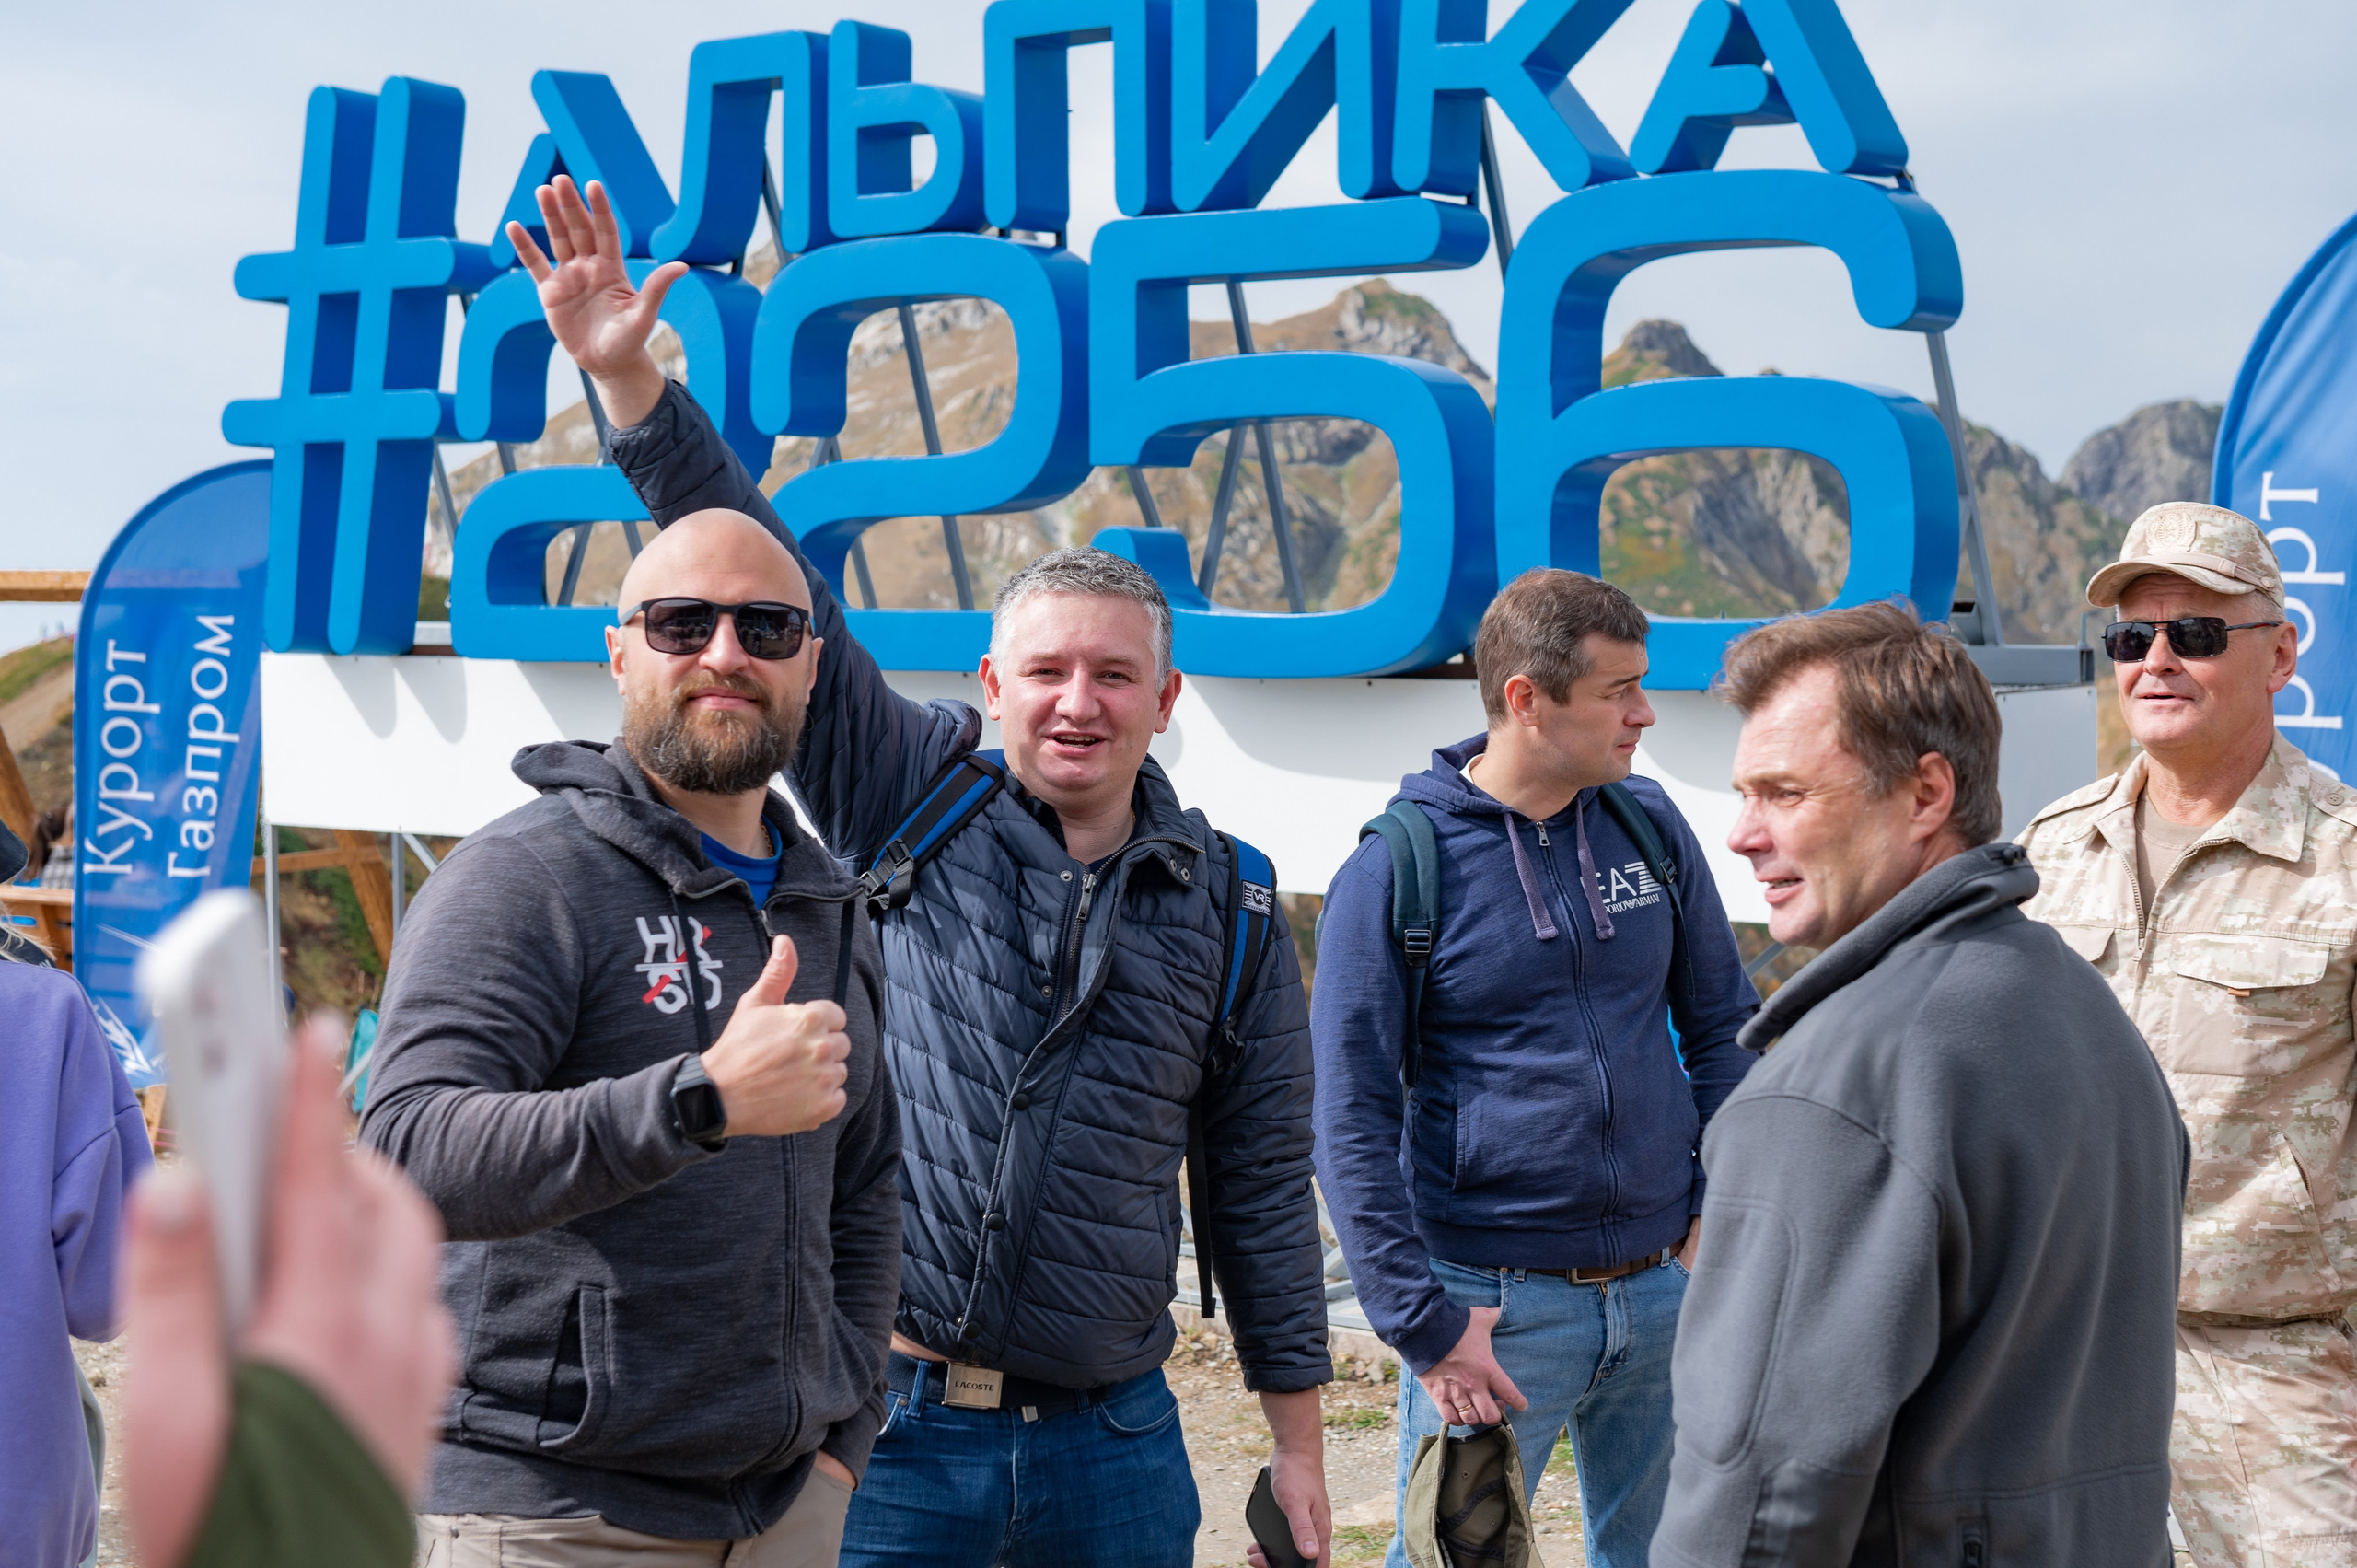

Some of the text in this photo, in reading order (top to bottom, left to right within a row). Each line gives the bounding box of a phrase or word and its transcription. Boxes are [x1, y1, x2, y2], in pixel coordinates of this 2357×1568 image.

[83, 639, 161, 875] Курорт
[167, 614, 240, 878] Газпром
[954, 1380, 995, 1392] LACOSTE
